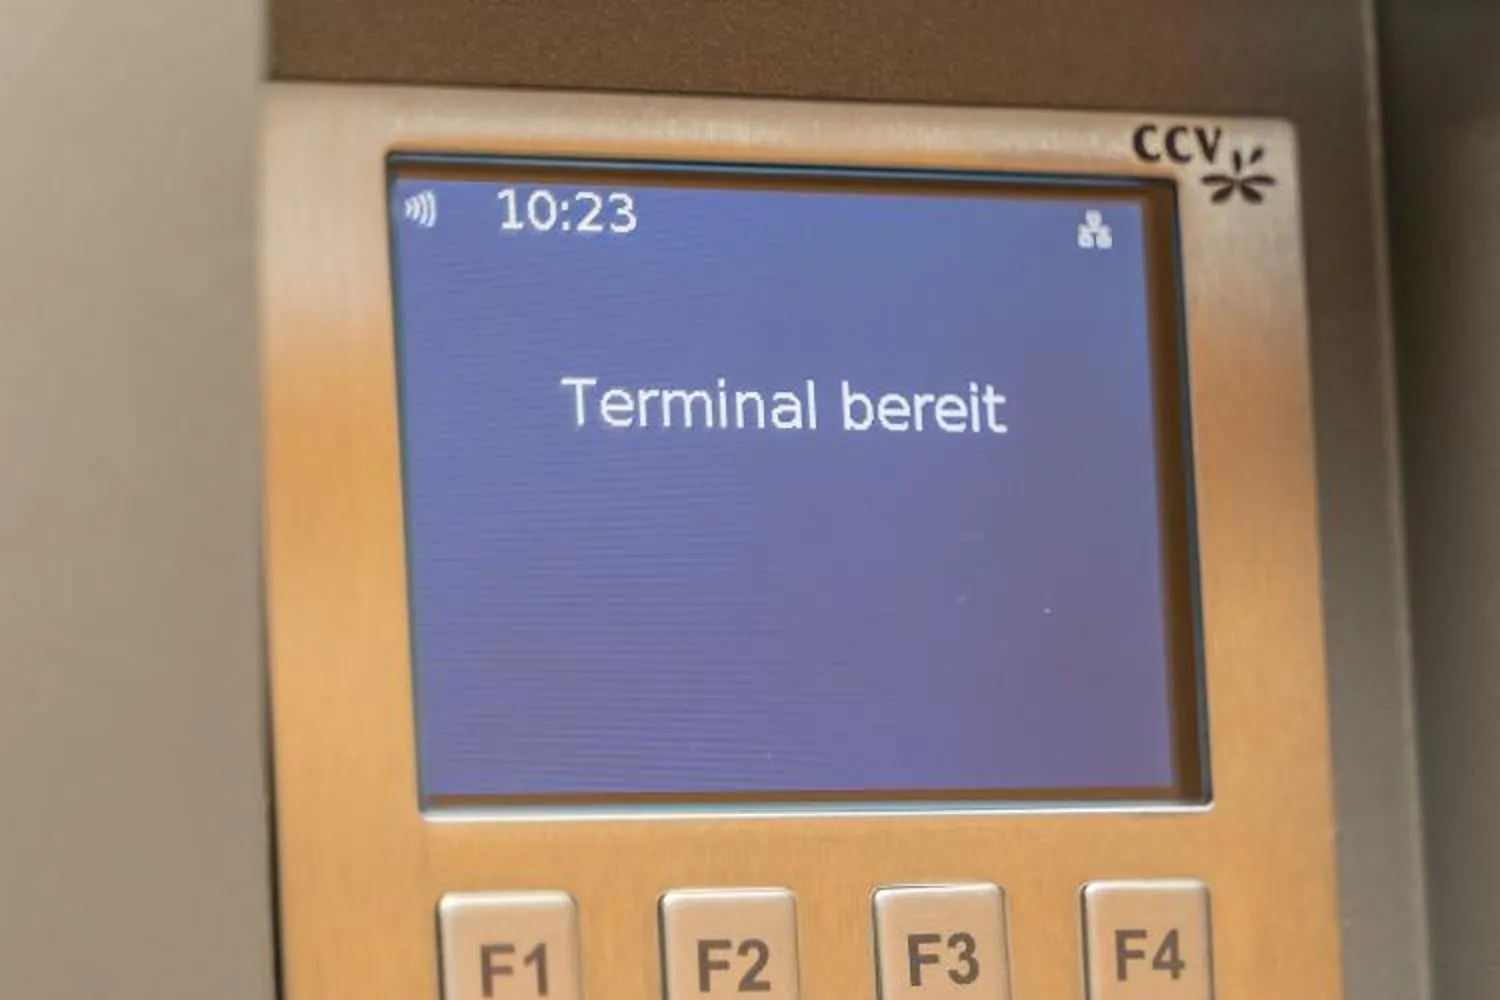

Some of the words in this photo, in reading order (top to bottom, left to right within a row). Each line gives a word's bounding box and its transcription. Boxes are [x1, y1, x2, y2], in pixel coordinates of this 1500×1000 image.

[1133, 125, 1223, 165] CCV
[497, 189, 638, 235] 10:23
[561, 376, 816, 431] Terminal
[841, 382, 1007, 434] bereit
[480, 942, 551, 999] F1
[697, 940, 771, 993] F2
[907, 931, 980, 986] F3
[1115, 928, 1185, 981] F4
